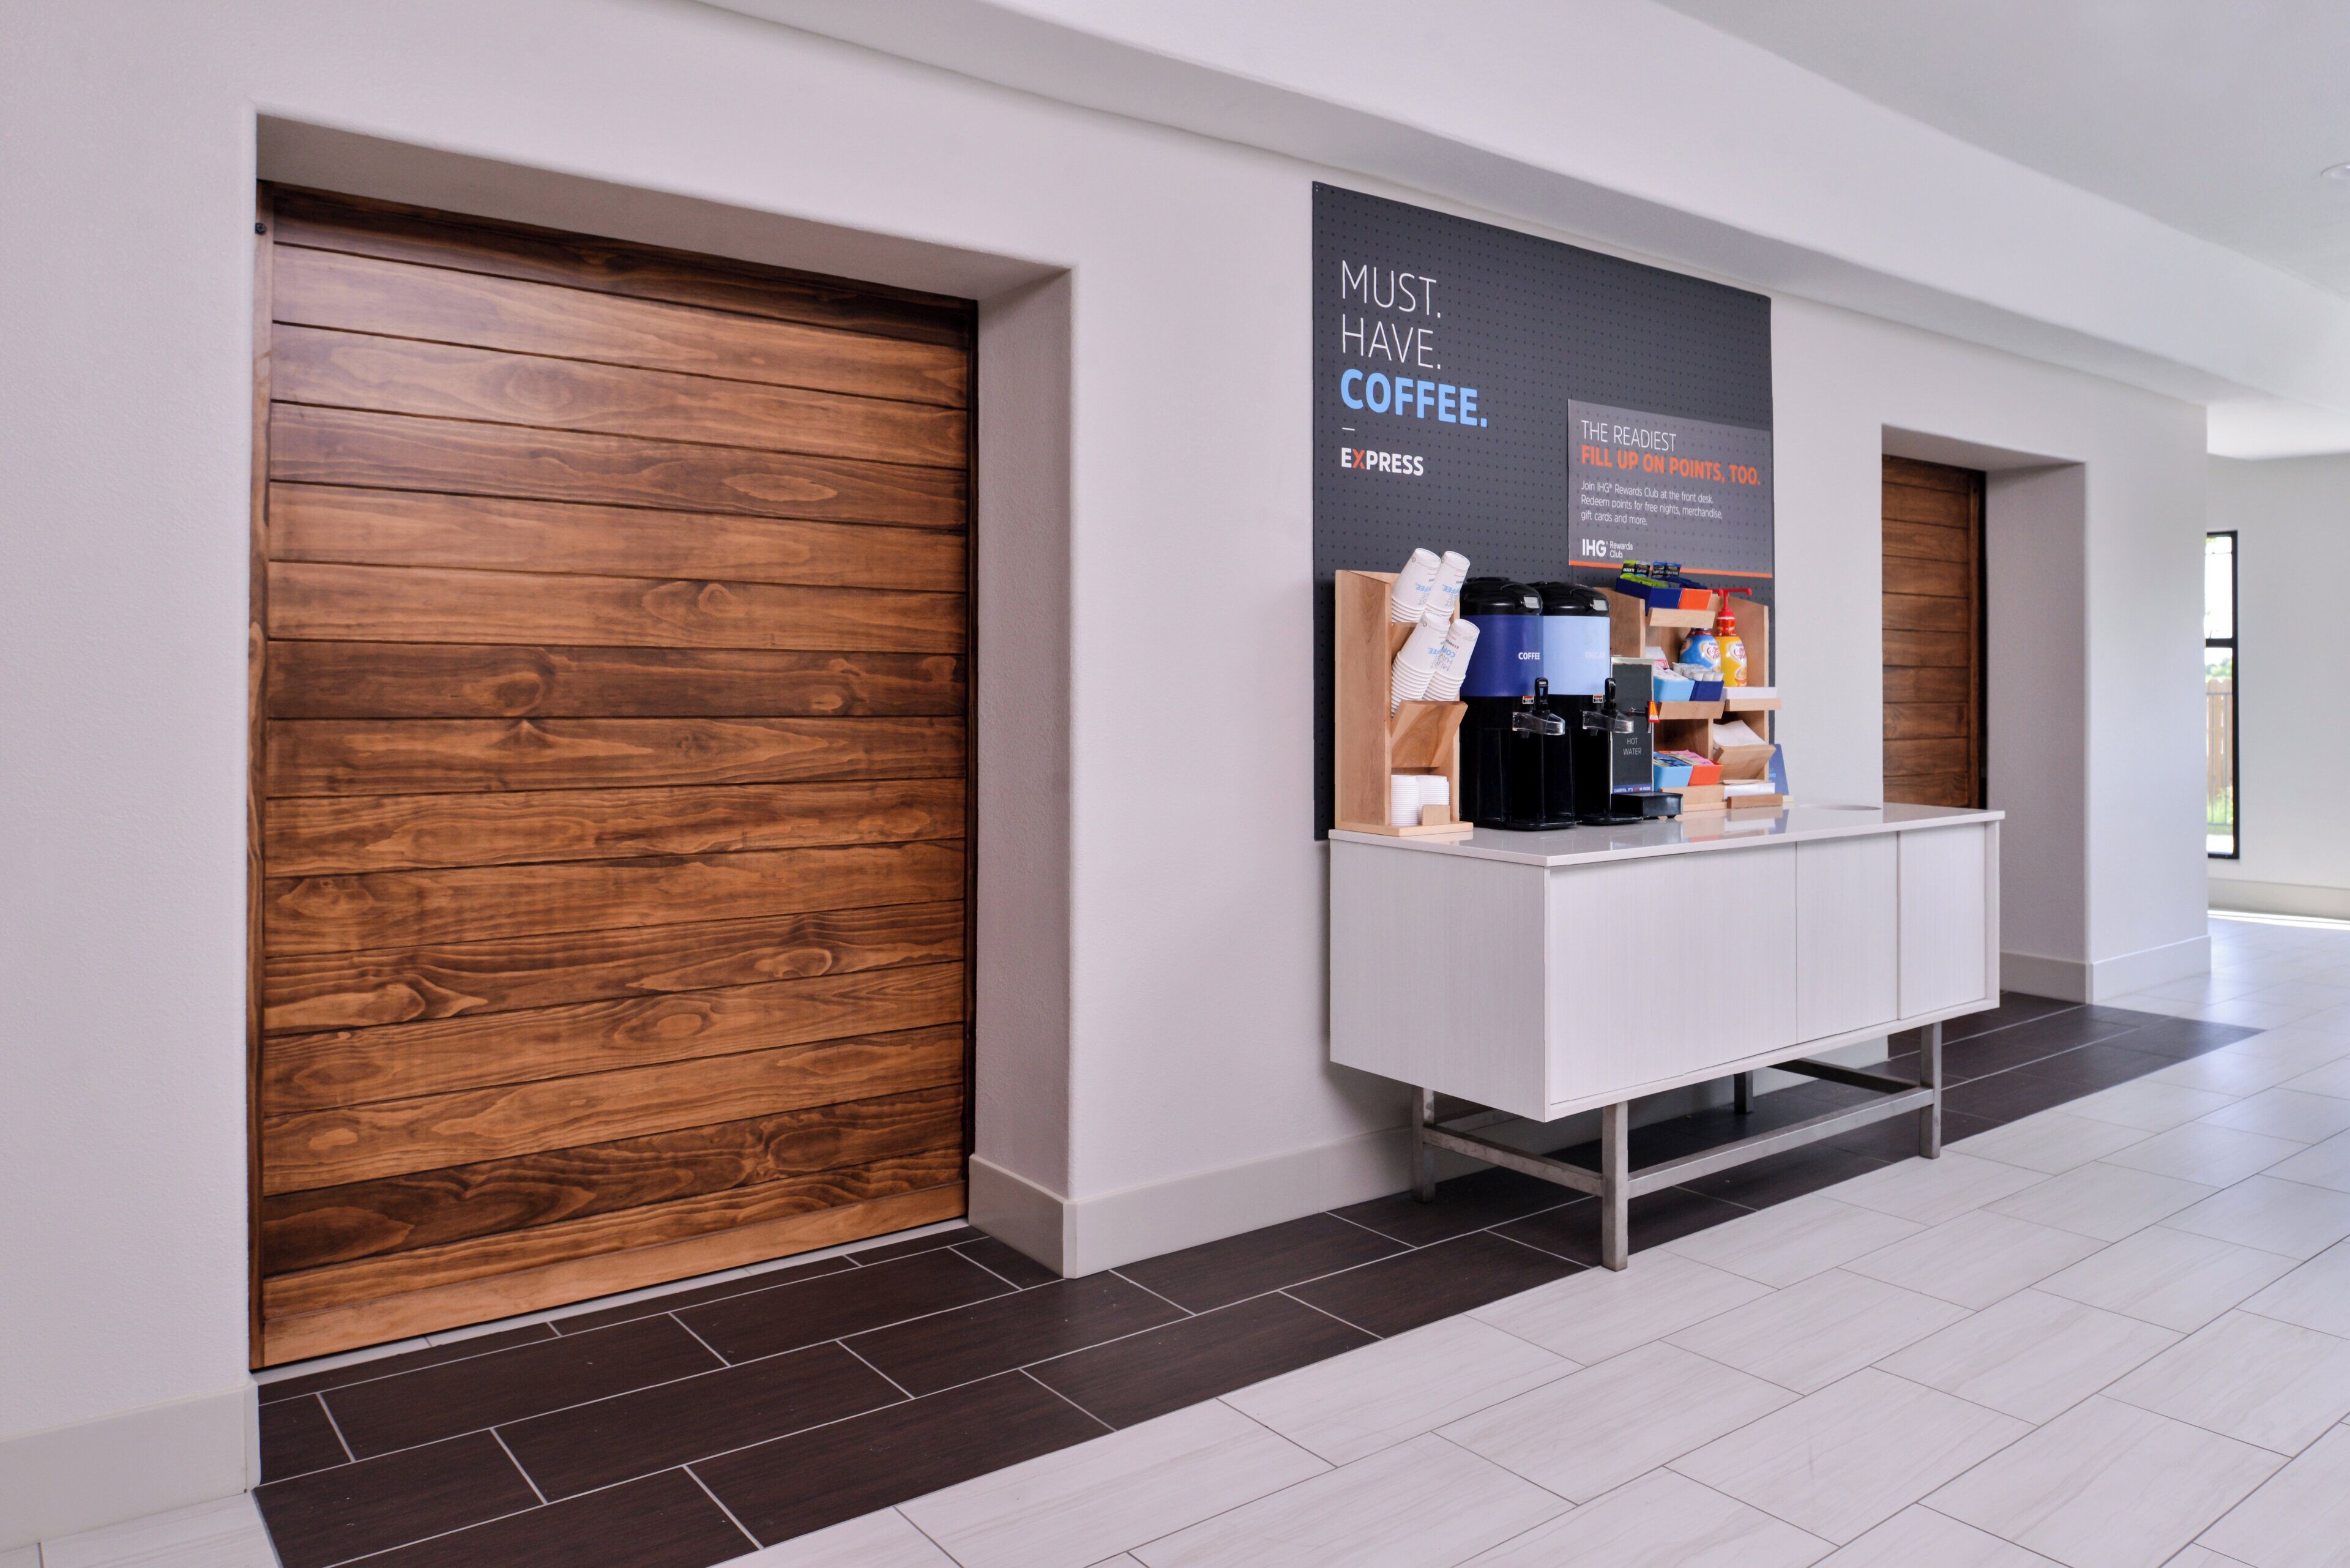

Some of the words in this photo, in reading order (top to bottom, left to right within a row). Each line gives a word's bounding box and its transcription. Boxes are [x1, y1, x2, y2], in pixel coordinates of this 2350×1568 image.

[1342, 260, 1441, 318] MUST.
[1342, 314, 1441, 369] HAVE.
[1341, 368, 1487, 428] COFFEE.
[1581, 420, 1608, 442] THE
[1614, 425, 1676, 452] READIEST
[1341, 447, 1424, 476] EXPRESS
[1581, 445, 1613, 468] FILL
[1617, 450, 1639, 470] UP
[1643, 453, 1665, 474] ON
[1669, 457, 1726, 483] POINTS,
[1729, 464, 1761, 485] TOO.
[1581, 480, 1595, 491] Join
[1615, 483, 1643, 496] Rewards
[1644, 487, 1658, 498] Club
[1669, 490, 1680, 500] the
[1681, 491, 1696, 502] front
[1698, 494, 1714, 504] desk.
[1581, 494, 1610, 507] Redeem
[1612, 499, 1632, 510] points
[1634, 500, 1643, 510] for
[1644, 501, 1658, 512] free
[1660, 504, 1680, 515] nights,
[1682, 506, 1723, 519] merchandise,
[1581, 509, 1592, 521] gift
[1594, 512, 1613, 522] cards
[1614, 514, 1627, 523] and
[1629, 516, 1647, 525] more.
[1610, 540, 1633, 550] Rewards
[1610, 550, 1623, 558] Club
